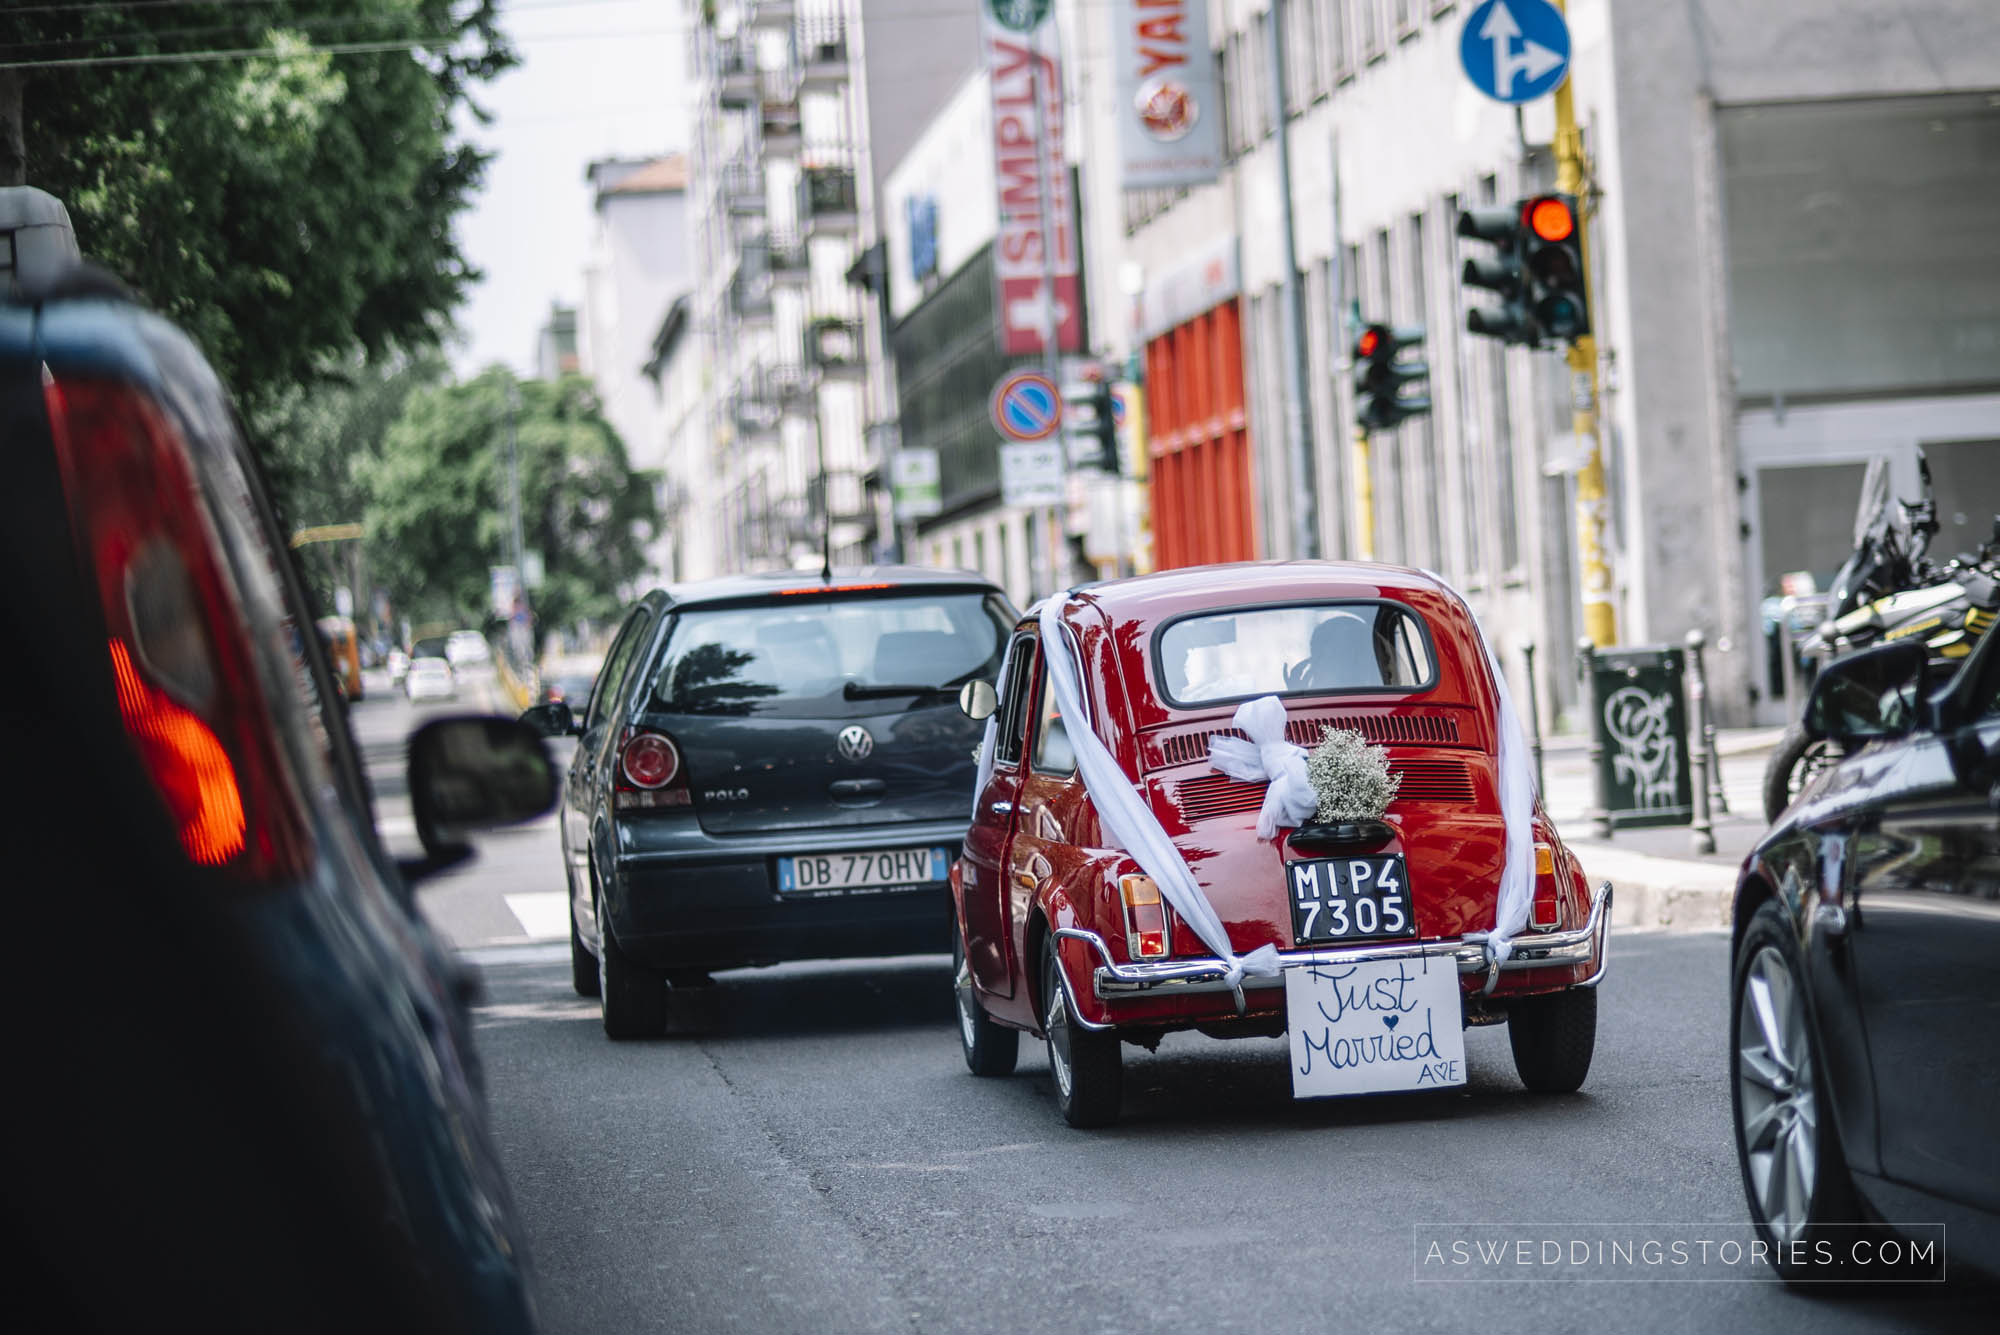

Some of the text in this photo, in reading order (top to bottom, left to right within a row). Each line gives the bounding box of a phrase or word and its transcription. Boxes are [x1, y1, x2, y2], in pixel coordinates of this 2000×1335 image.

[704, 788, 749, 801] POLO
[798, 858, 832, 886] DB
[842, 851, 927, 883] 770HV
[1298, 896, 1405, 938] 7305
[1306, 961, 1418, 1023] Just
[1300, 1008, 1442, 1075] Married
